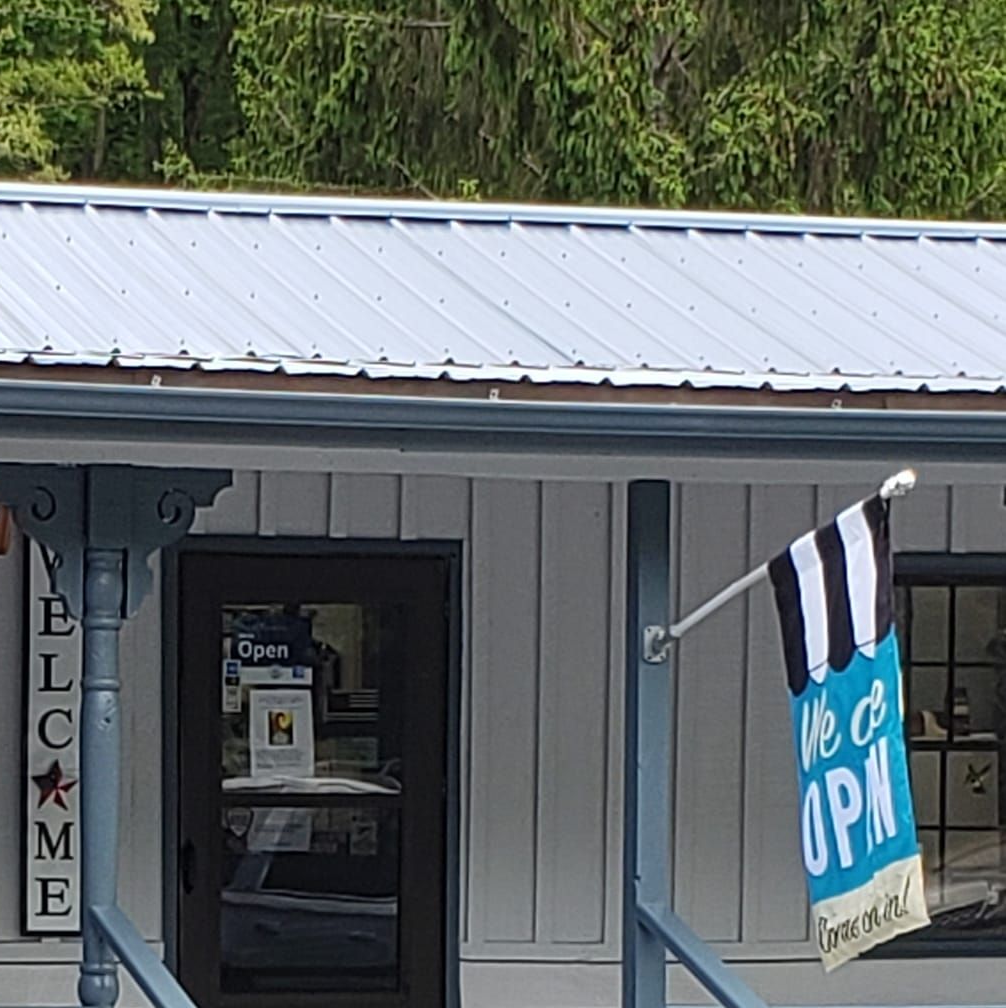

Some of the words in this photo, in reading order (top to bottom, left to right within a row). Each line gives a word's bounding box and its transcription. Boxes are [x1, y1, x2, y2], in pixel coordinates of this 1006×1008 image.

[238, 641, 289, 662] Open
[802, 688, 842, 772] We
[851, 679, 887, 747] ae
[802, 736, 897, 876] OPN
